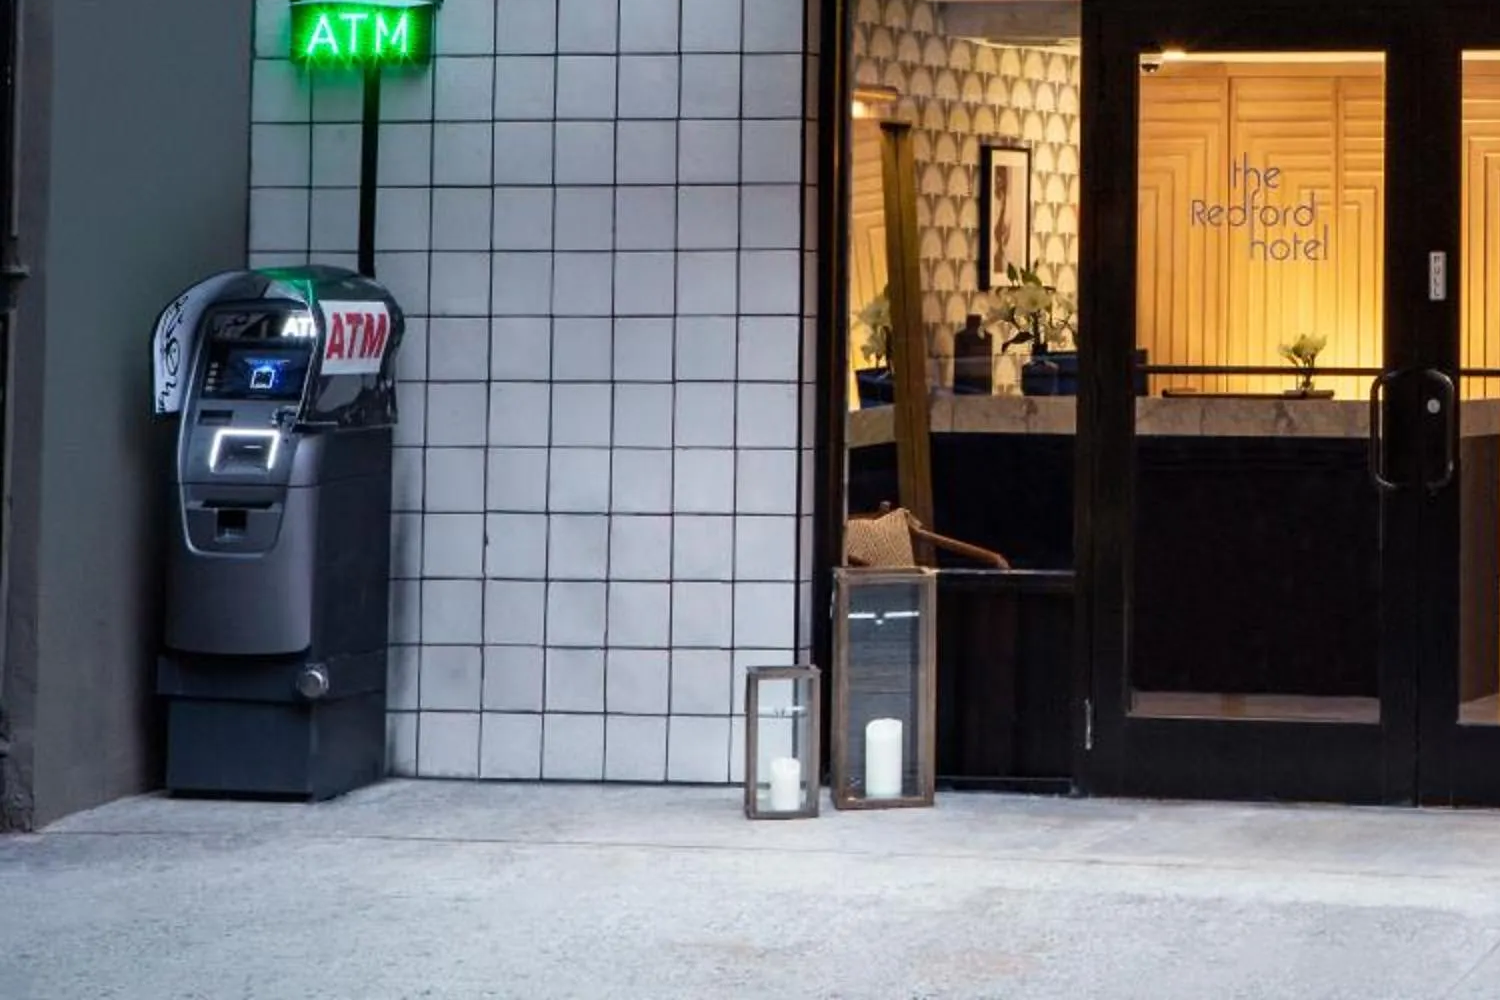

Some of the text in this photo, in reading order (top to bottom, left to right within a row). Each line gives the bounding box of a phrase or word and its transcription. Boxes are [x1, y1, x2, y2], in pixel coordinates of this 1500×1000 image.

[306, 10, 409, 56] ATM
[1232, 151, 1282, 190] the
[1191, 188, 1316, 227] Redford
[1249, 223, 1329, 262] hotel
[281, 316, 317, 338] AT
[326, 311, 389, 361] ATM
